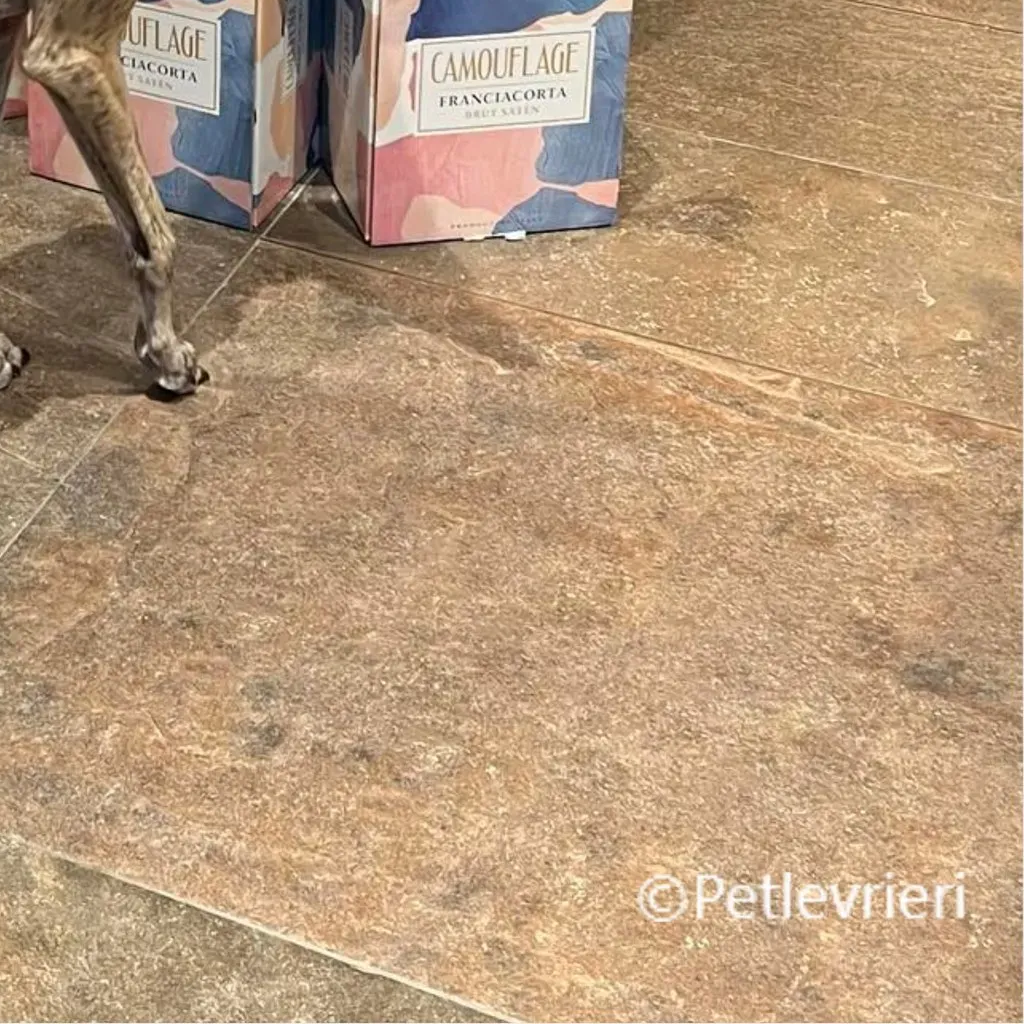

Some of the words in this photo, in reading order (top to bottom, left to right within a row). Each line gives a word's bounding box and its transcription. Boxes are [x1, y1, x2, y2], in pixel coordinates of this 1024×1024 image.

[129, 14, 208, 62] UFLAGE
[120, 55, 198, 84] CIACORTA
[431, 41, 580, 84] CAMOUFLAGE
[439, 87, 568, 108] FRANCIACORTA
